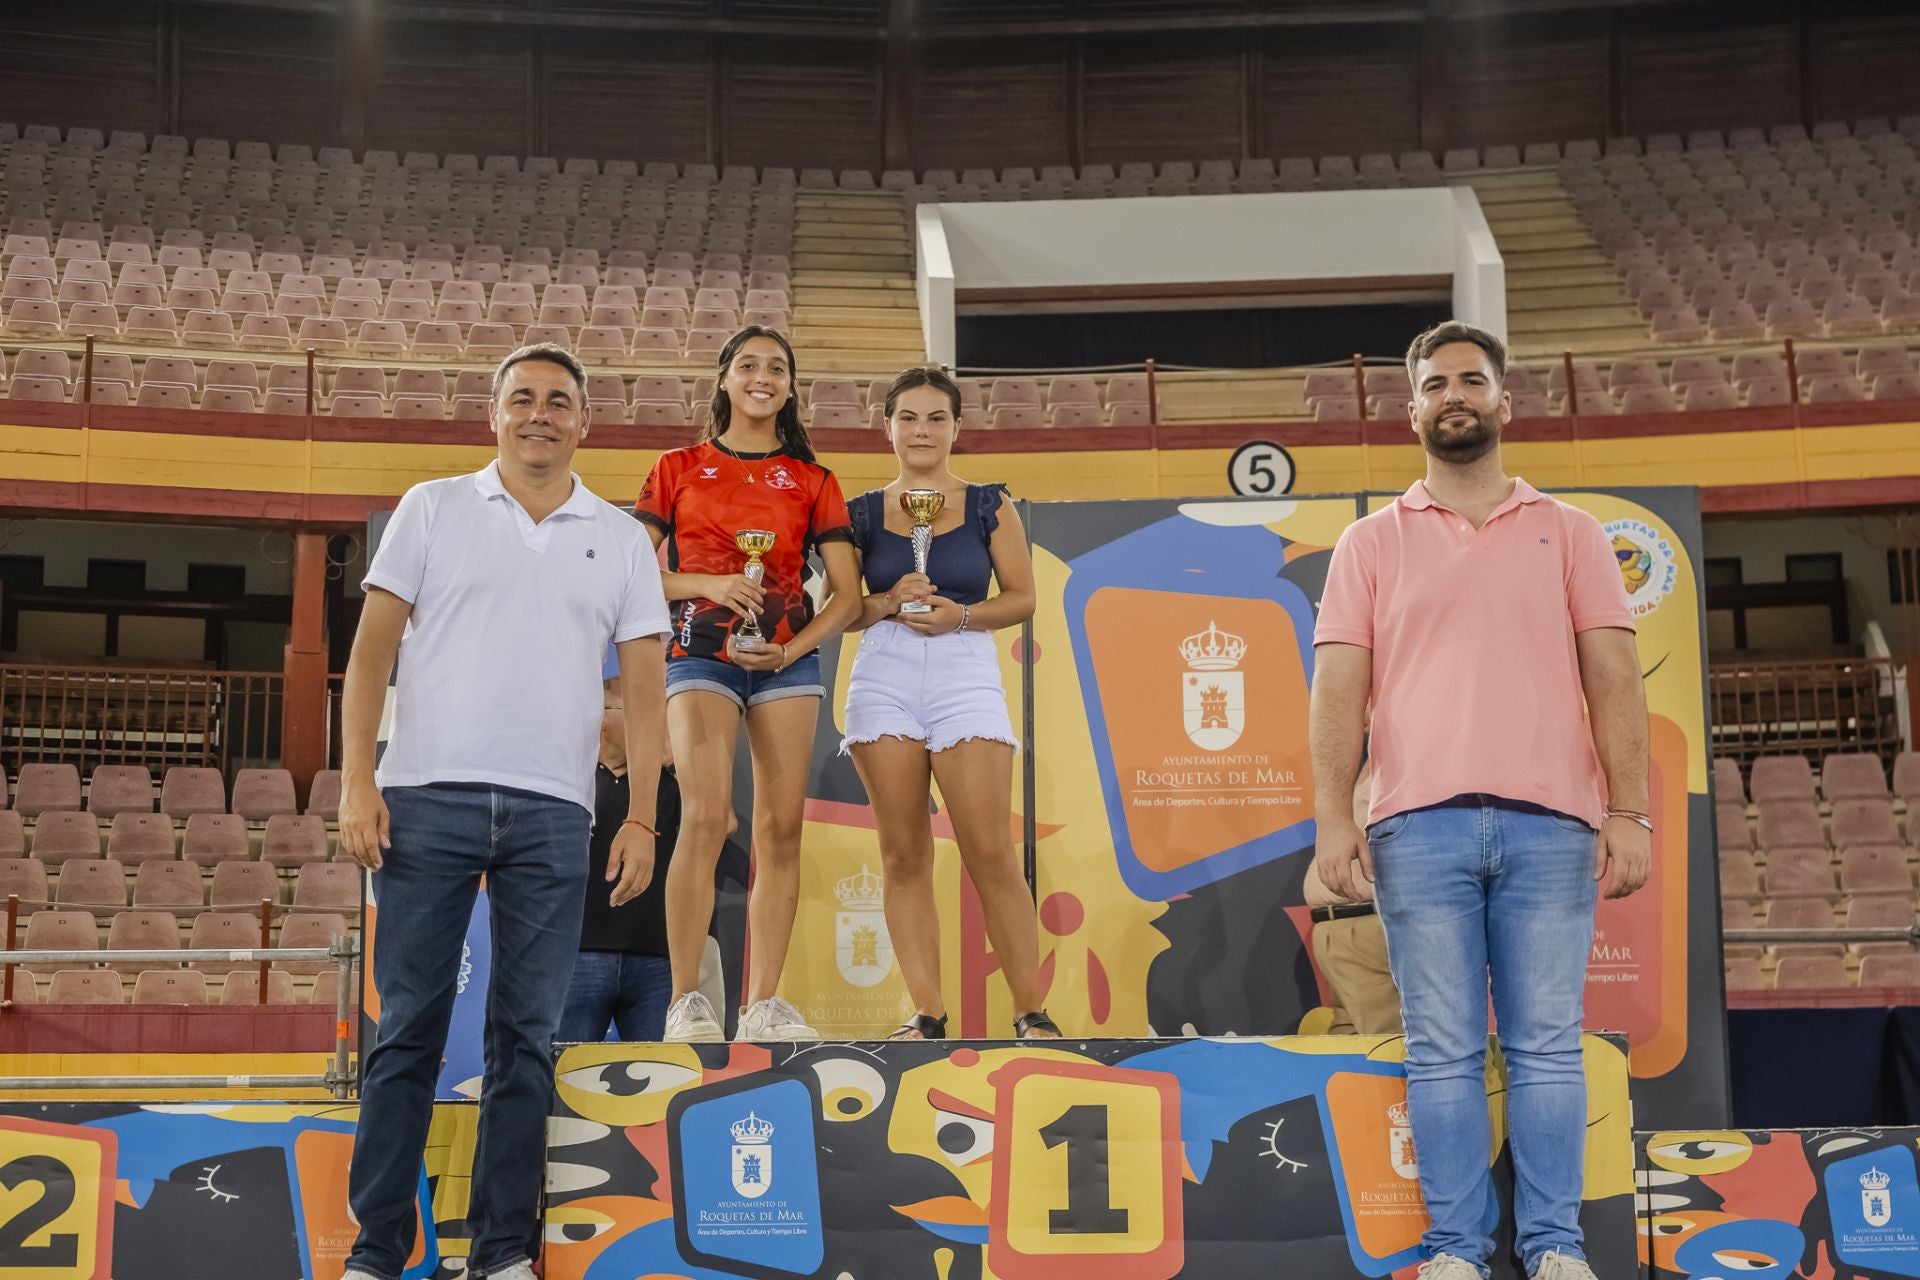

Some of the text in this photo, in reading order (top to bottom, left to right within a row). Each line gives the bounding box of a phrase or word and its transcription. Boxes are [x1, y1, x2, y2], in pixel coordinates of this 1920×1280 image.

[1249, 454, 1275, 493] 5
[1604, 521, 1675, 592] QUETAS DE MAR
[1162, 754, 1270, 766] AYUNTAMIENTO DE
[1136, 768, 1296, 788] ROQUETAS DE MAR
[1153, 797, 1165, 807] de
[1207, 796, 1239, 806] Cultura
[1240, 798, 1247, 807] y
[1247, 796, 1279, 807] Tiempo
[1280, 795, 1302, 805] Libre
[1592, 944, 1632, 960] MAR
[1616, 972, 1639, 981] Libre
[815, 991, 899, 1001] AYUNTAMIENTO
[877, 1007, 897, 1020] DE
[1039, 1105, 1128, 1234] 1
[1361, 1191, 1417, 1203] ROQUETAS
[0, 1155, 79, 1267] 2
[700, 1209, 804, 1222] ROQUETAS DE MAR
[793, 1227, 807, 1235] Libre
[1843, 1235, 1882, 1243] ROQUETAS
[1897, 1234, 1916, 1242] MAR
